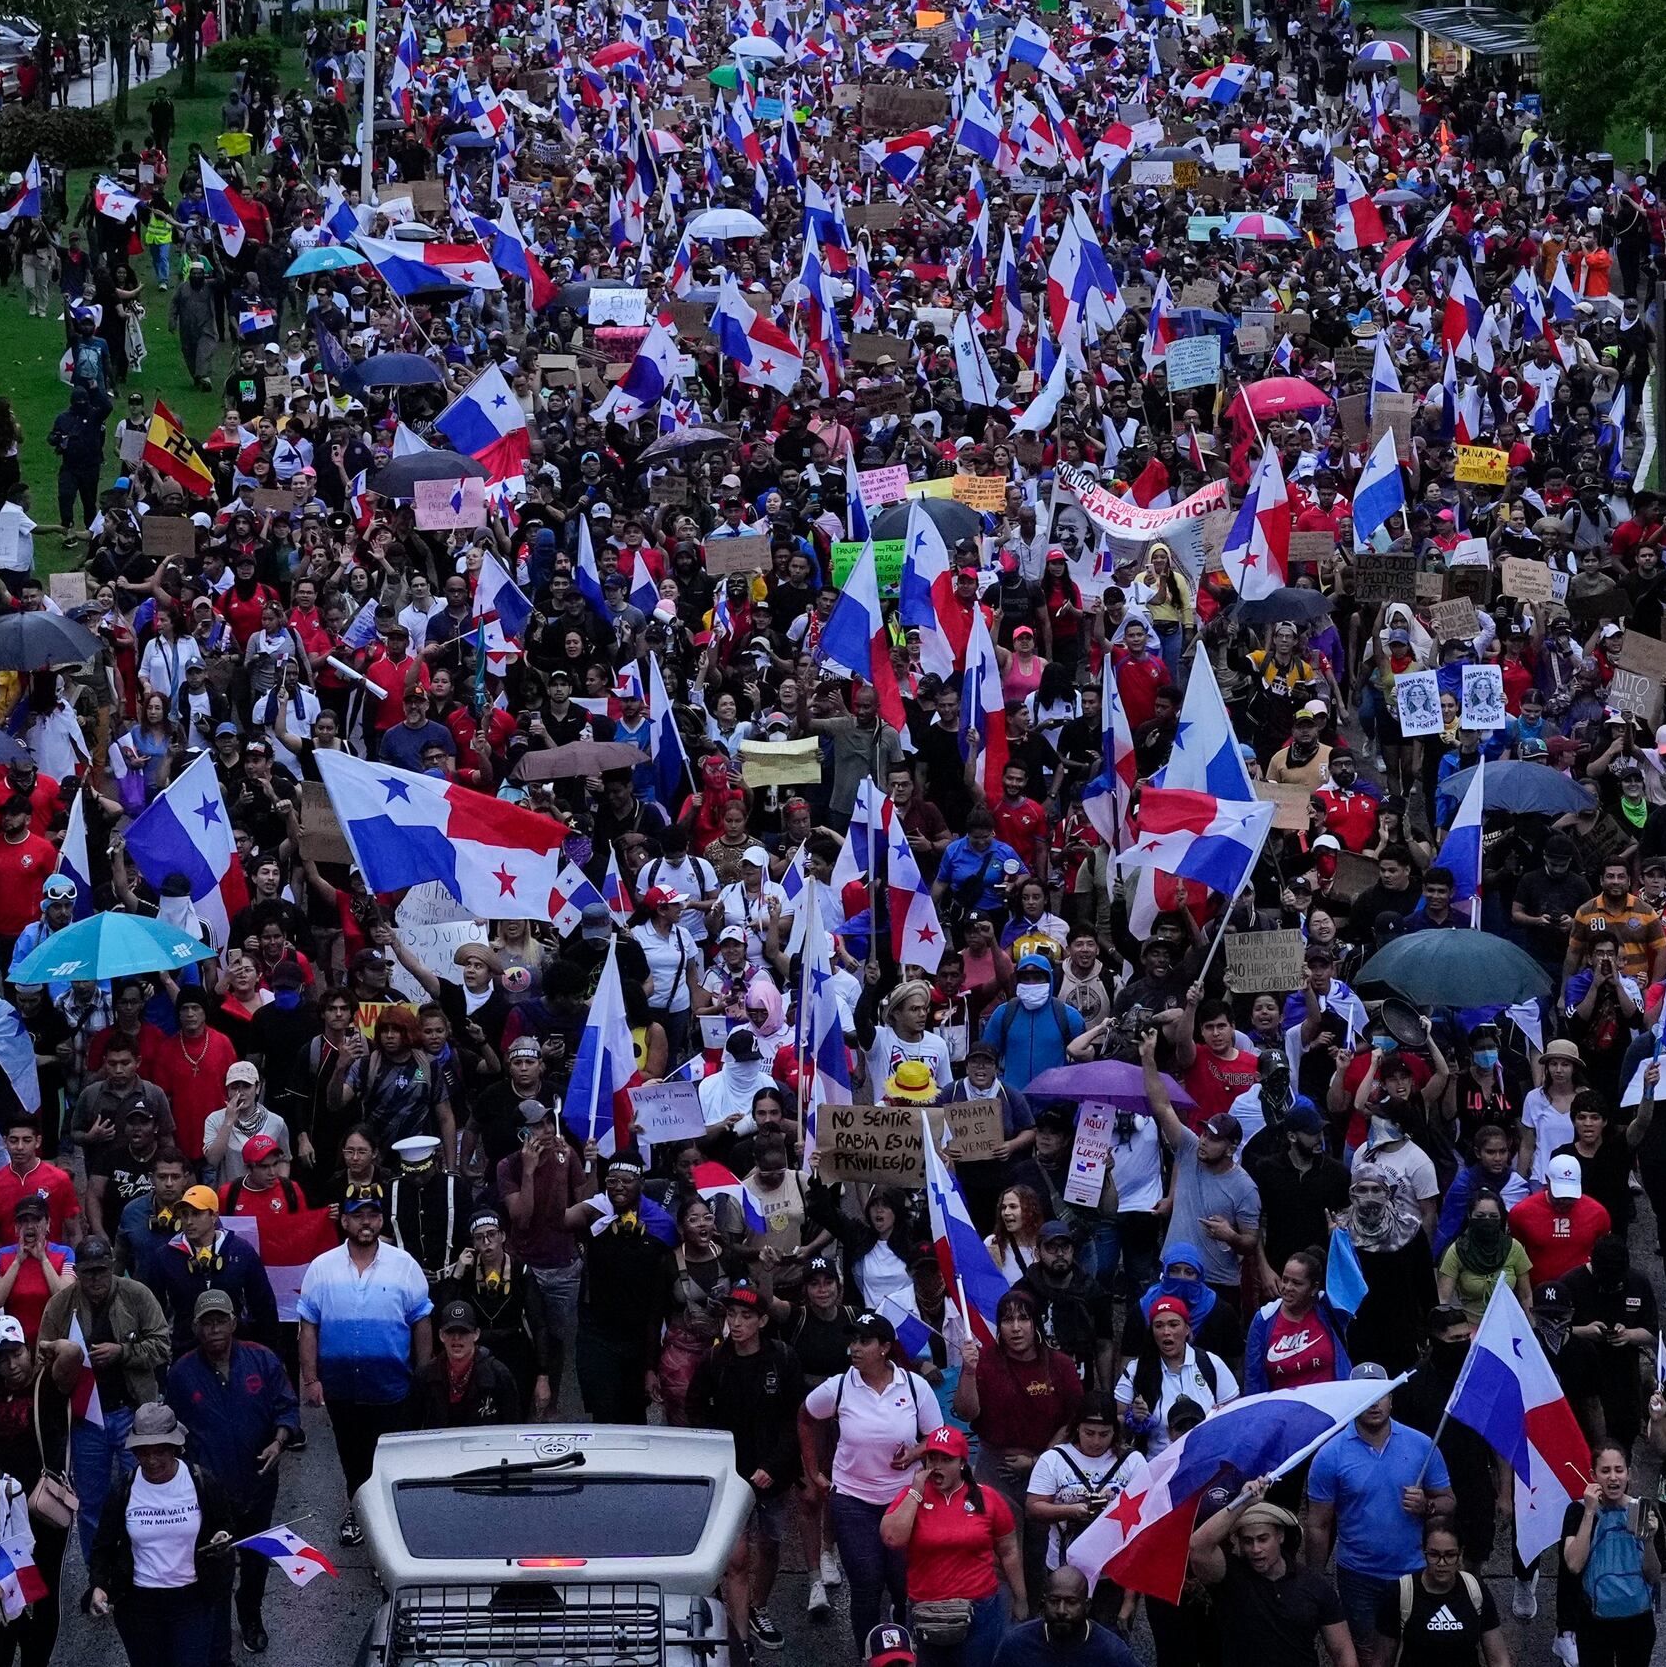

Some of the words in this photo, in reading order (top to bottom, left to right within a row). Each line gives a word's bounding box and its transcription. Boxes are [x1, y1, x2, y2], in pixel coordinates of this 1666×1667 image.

[1461, 447, 1501, 460] PANAMA
[1080, 492, 1132, 528] HARA
[1358, 556, 1383, 570] LOS
[1590, 917, 1606, 931] 80
[1239, 934, 1250, 945] NO
[1268, 932, 1304, 944] JUSTICIA
[1266, 946, 1294, 958] PUEBLO
[1231, 964, 1245, 977] NO
[1261, 977, 1305, 990] GOBIERNO
[1271, 1051, 1282, 1061] NY
[645, 1093, 666, 1103] poder
[660, 1104, 672, 1112] del
[950, 1105, 995, 1121] PANAMA
[832, 1110, 855, 1130] NO
[863, 1109, 912, 1127] SENTIR
[1084, 1117, 1108, 1131] AQUÍ
[954, 1125, 968, 1138] NO
[974, 1122, 986, 1135] SE
[885, 1134, 901, 1151] ES
[905, 1134, 922, 1150] UN
[961, 1140, 995, 1152] VENDE
[1077, 1147, 1106, 1161] LUCHA
[1552, 1218, 1571, 1233] 12
[812, 1258, 826, 1269] NY
[1545, 1287, 1556, 1301] NY
[1275, 1329, 1310, 1352] NIKE
[1276, 1358, 1321, 1374] AIR
[935, 1429, 950, 1443] NY
[133, 1509, 166, 1517] PANAMÁ
[168, 1507, 186, 1515] VALE
[155, 1516, 188, 1525] MINERÍA
[1427, 1620, 1464, 1631] adidas
